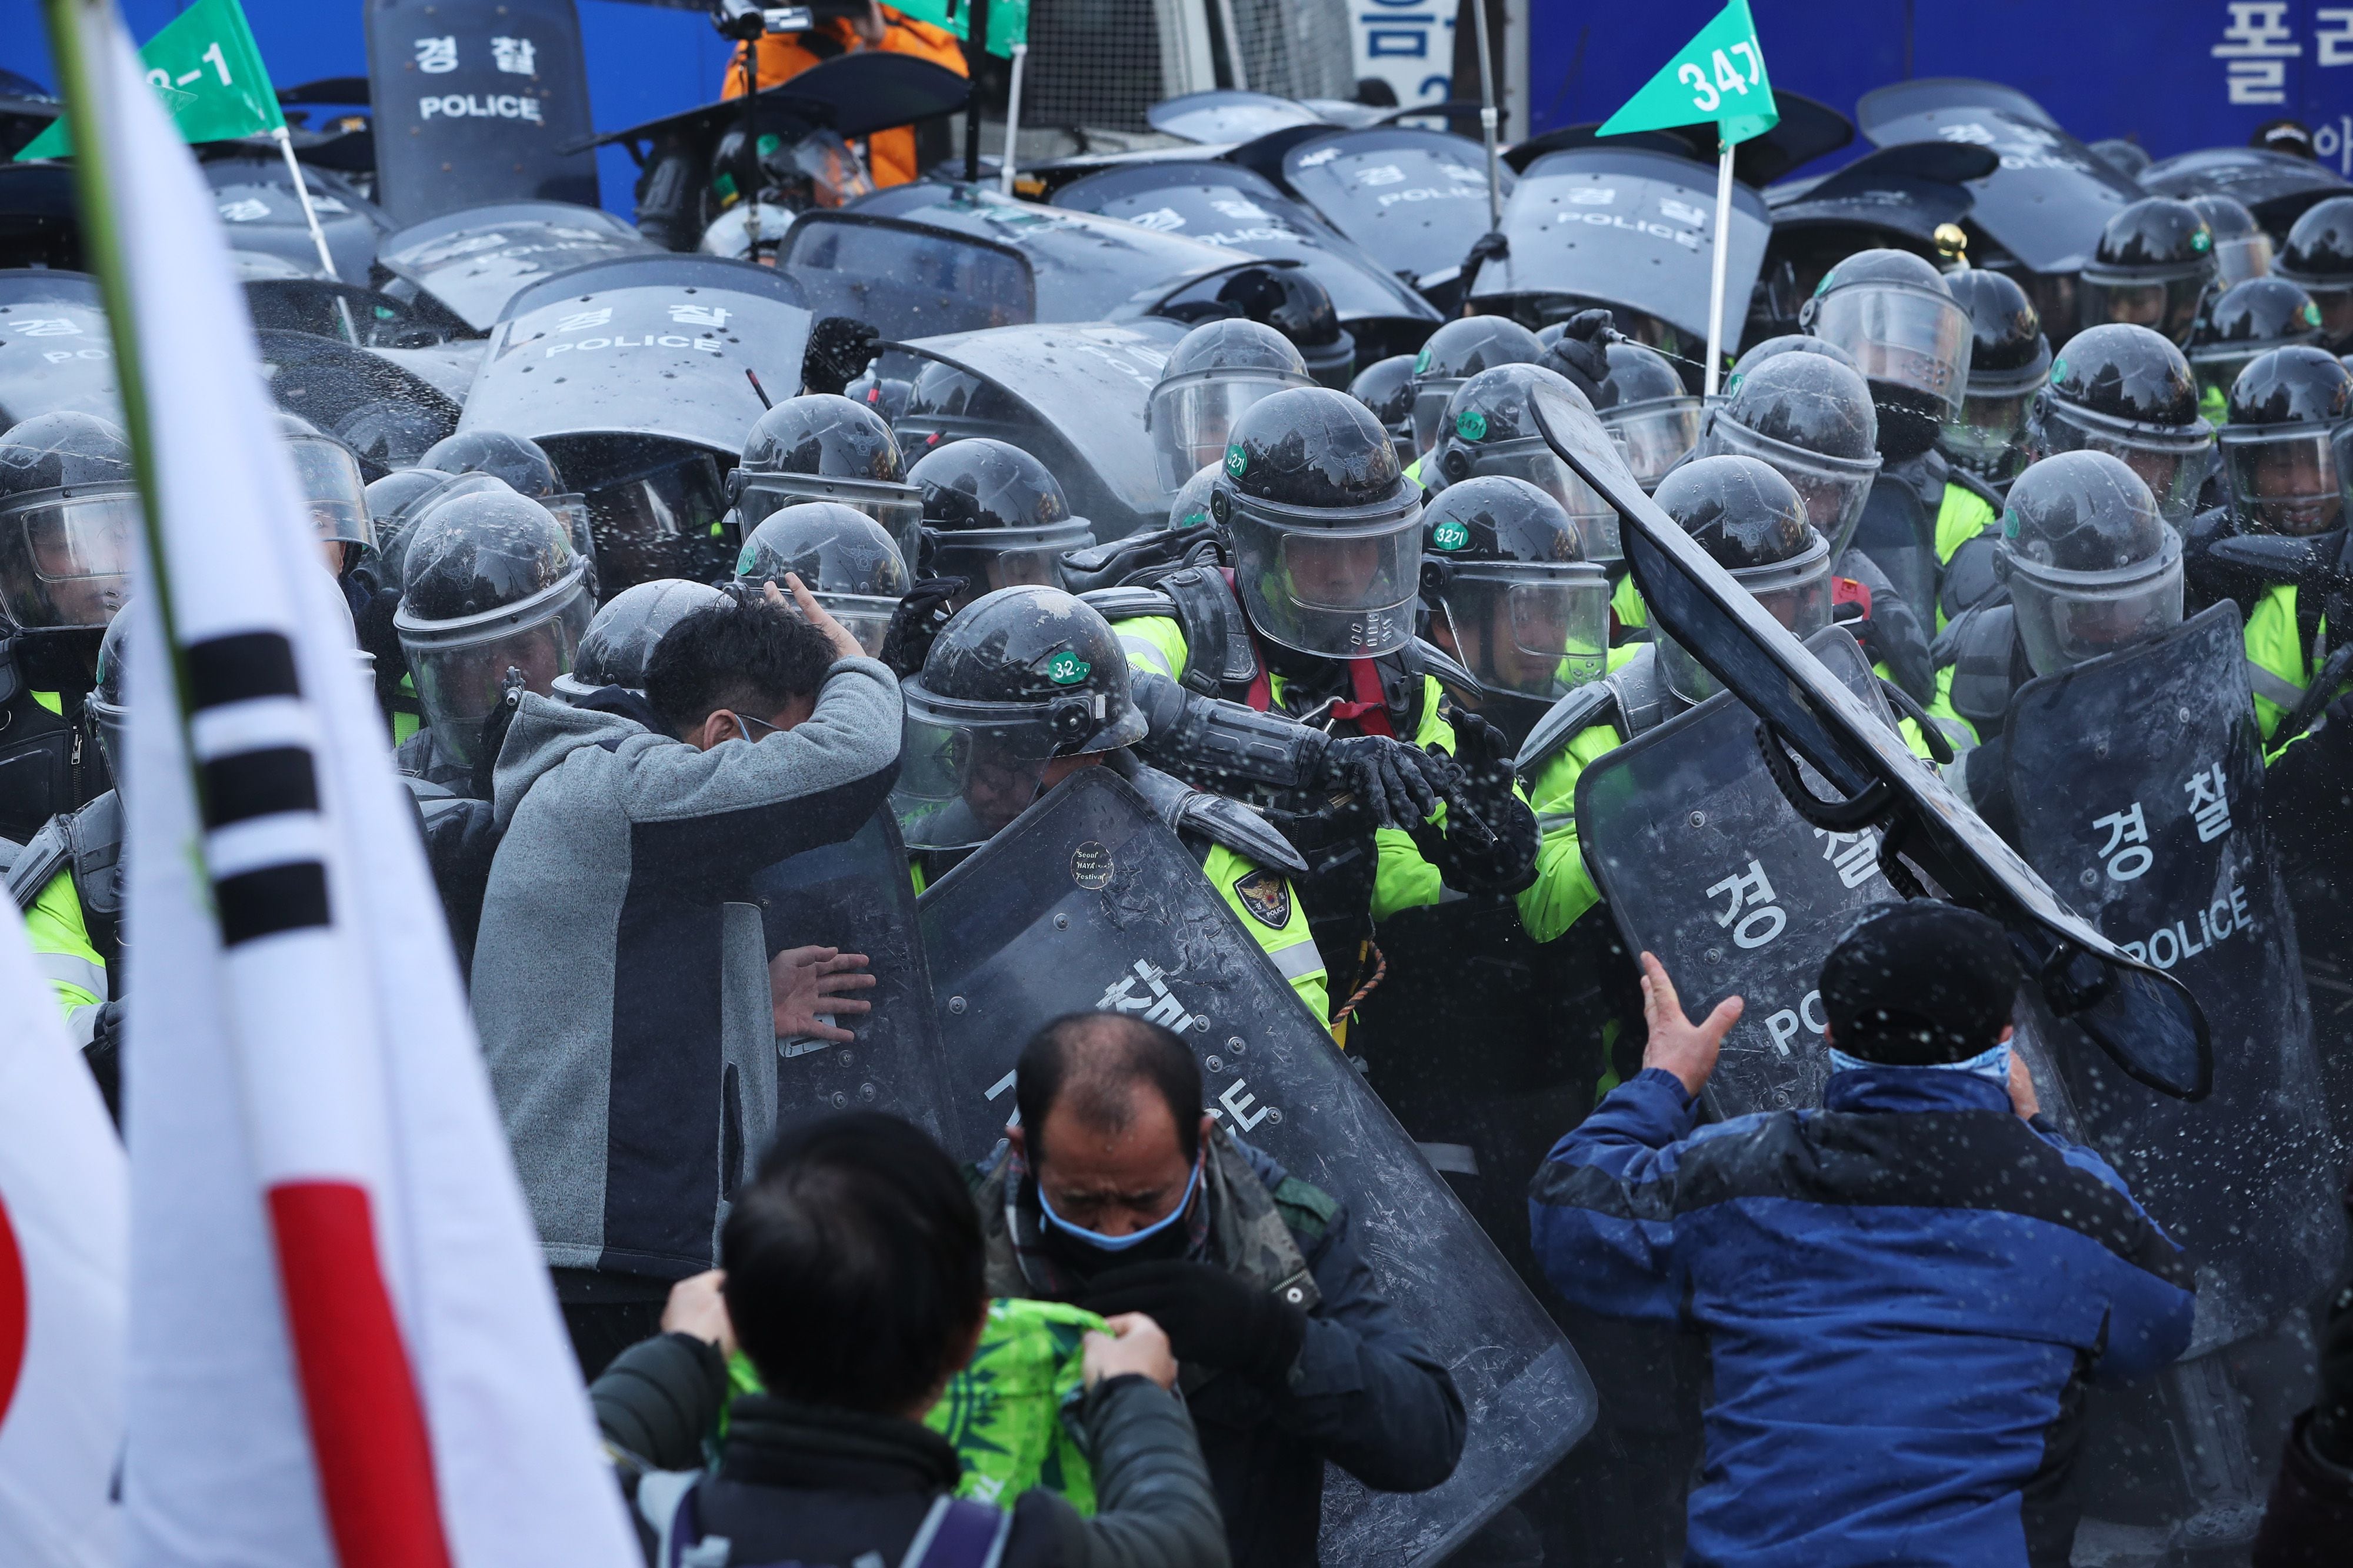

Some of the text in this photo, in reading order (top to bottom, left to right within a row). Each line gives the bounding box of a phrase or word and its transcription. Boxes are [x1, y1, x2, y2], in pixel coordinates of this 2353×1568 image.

[419, 94, 543, 120] POLICE
[1557, 211, 1699, 249] POLICE
[545, 334, 723, 359] POLICE
[1266, 905, 1285, 918] POLICE
